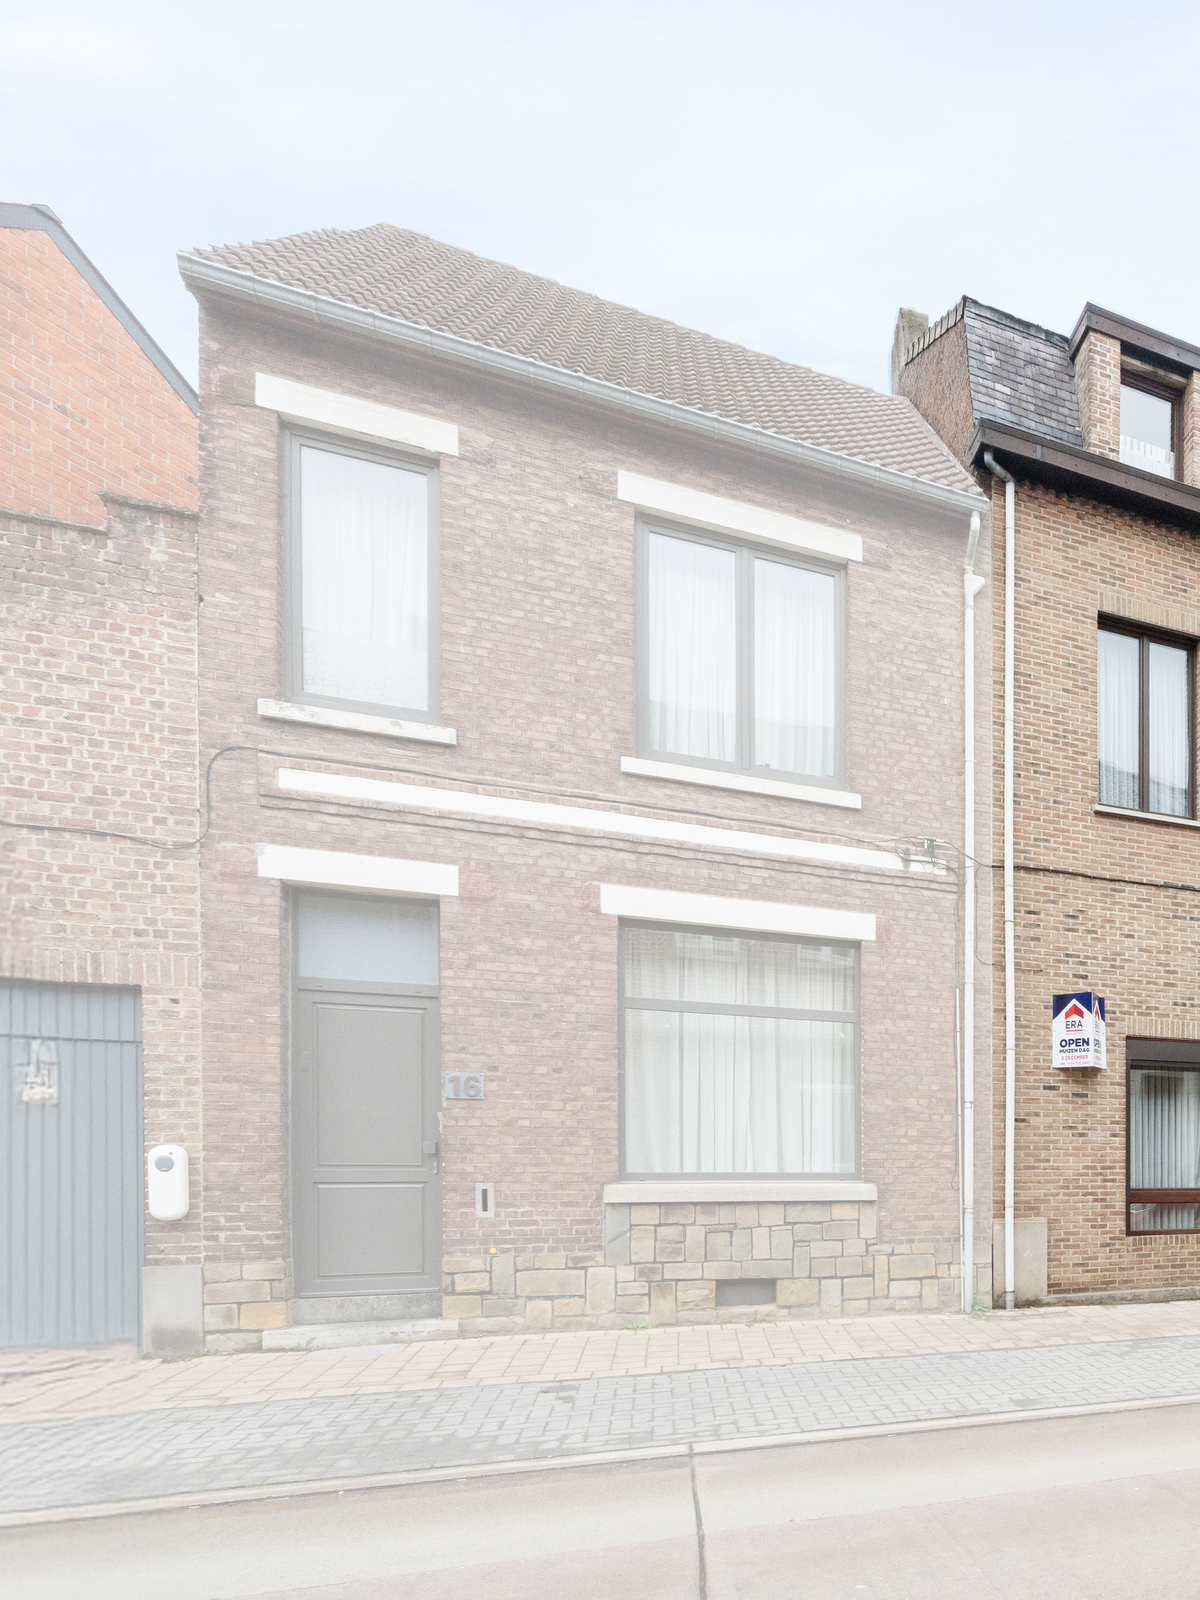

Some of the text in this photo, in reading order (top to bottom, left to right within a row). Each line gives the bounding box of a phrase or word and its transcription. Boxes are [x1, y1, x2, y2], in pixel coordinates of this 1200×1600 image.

[1066, 1020, 1083, 1029] ERA
[1060, 1038, 1090, 1048] OPEN
[448, 1075, 480, 1098] 16
